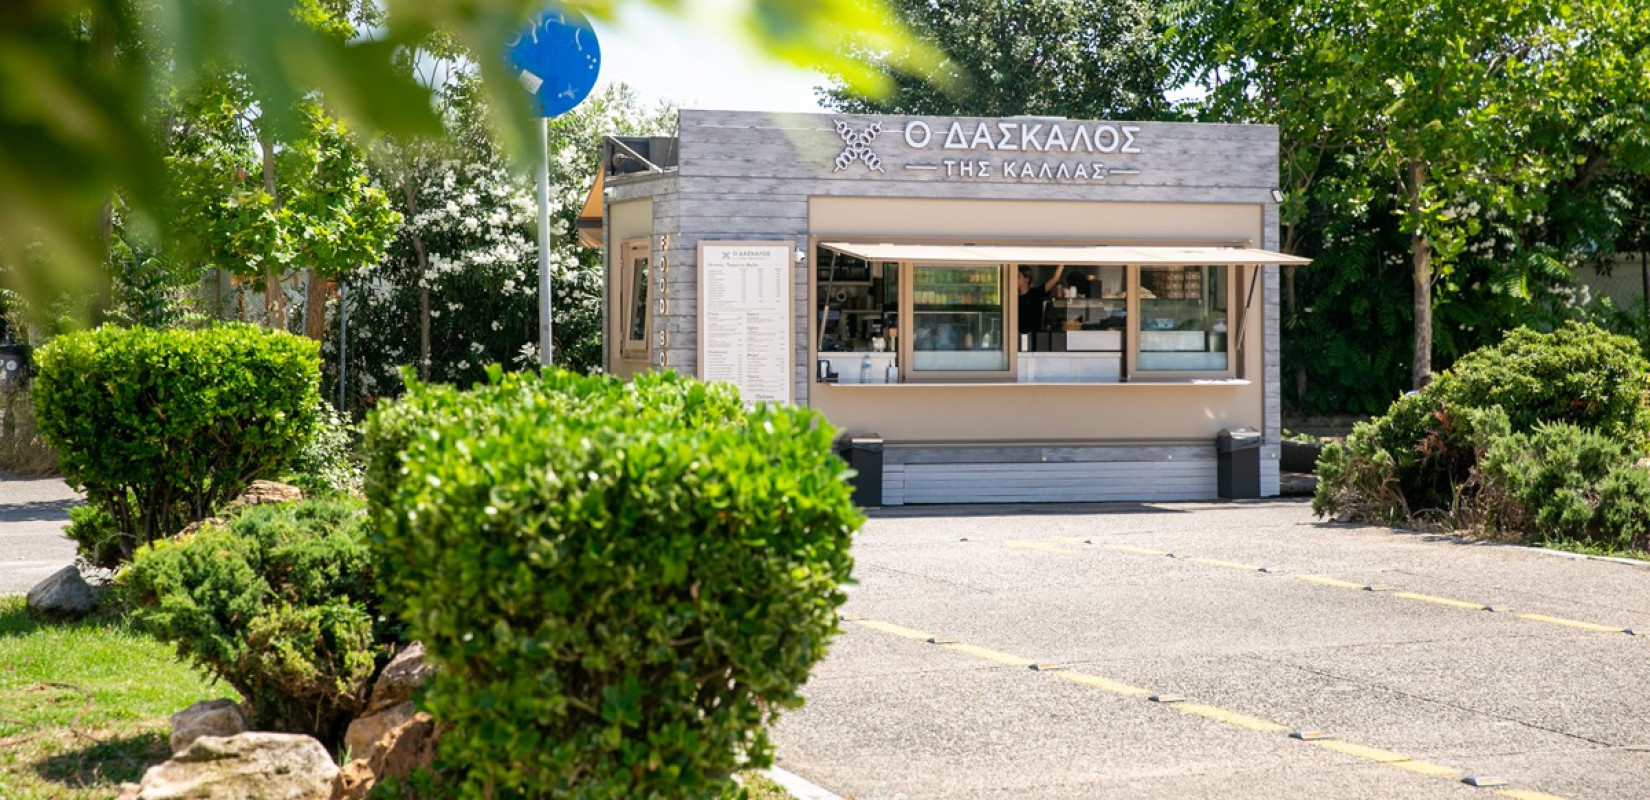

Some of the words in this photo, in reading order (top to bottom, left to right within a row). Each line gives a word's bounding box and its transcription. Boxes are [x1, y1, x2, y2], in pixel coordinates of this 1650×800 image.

[904, 120, 932, 148] Ο
[944, 121, 1141, 153] ΔΑΣΚΑΛΟΣ
[944, 160, 990, 177] ΤΗΣ
[1003, 161, 1105, 180] ΚΑΛΛΑΣ
[660, 232, 669, 315] FOOD
